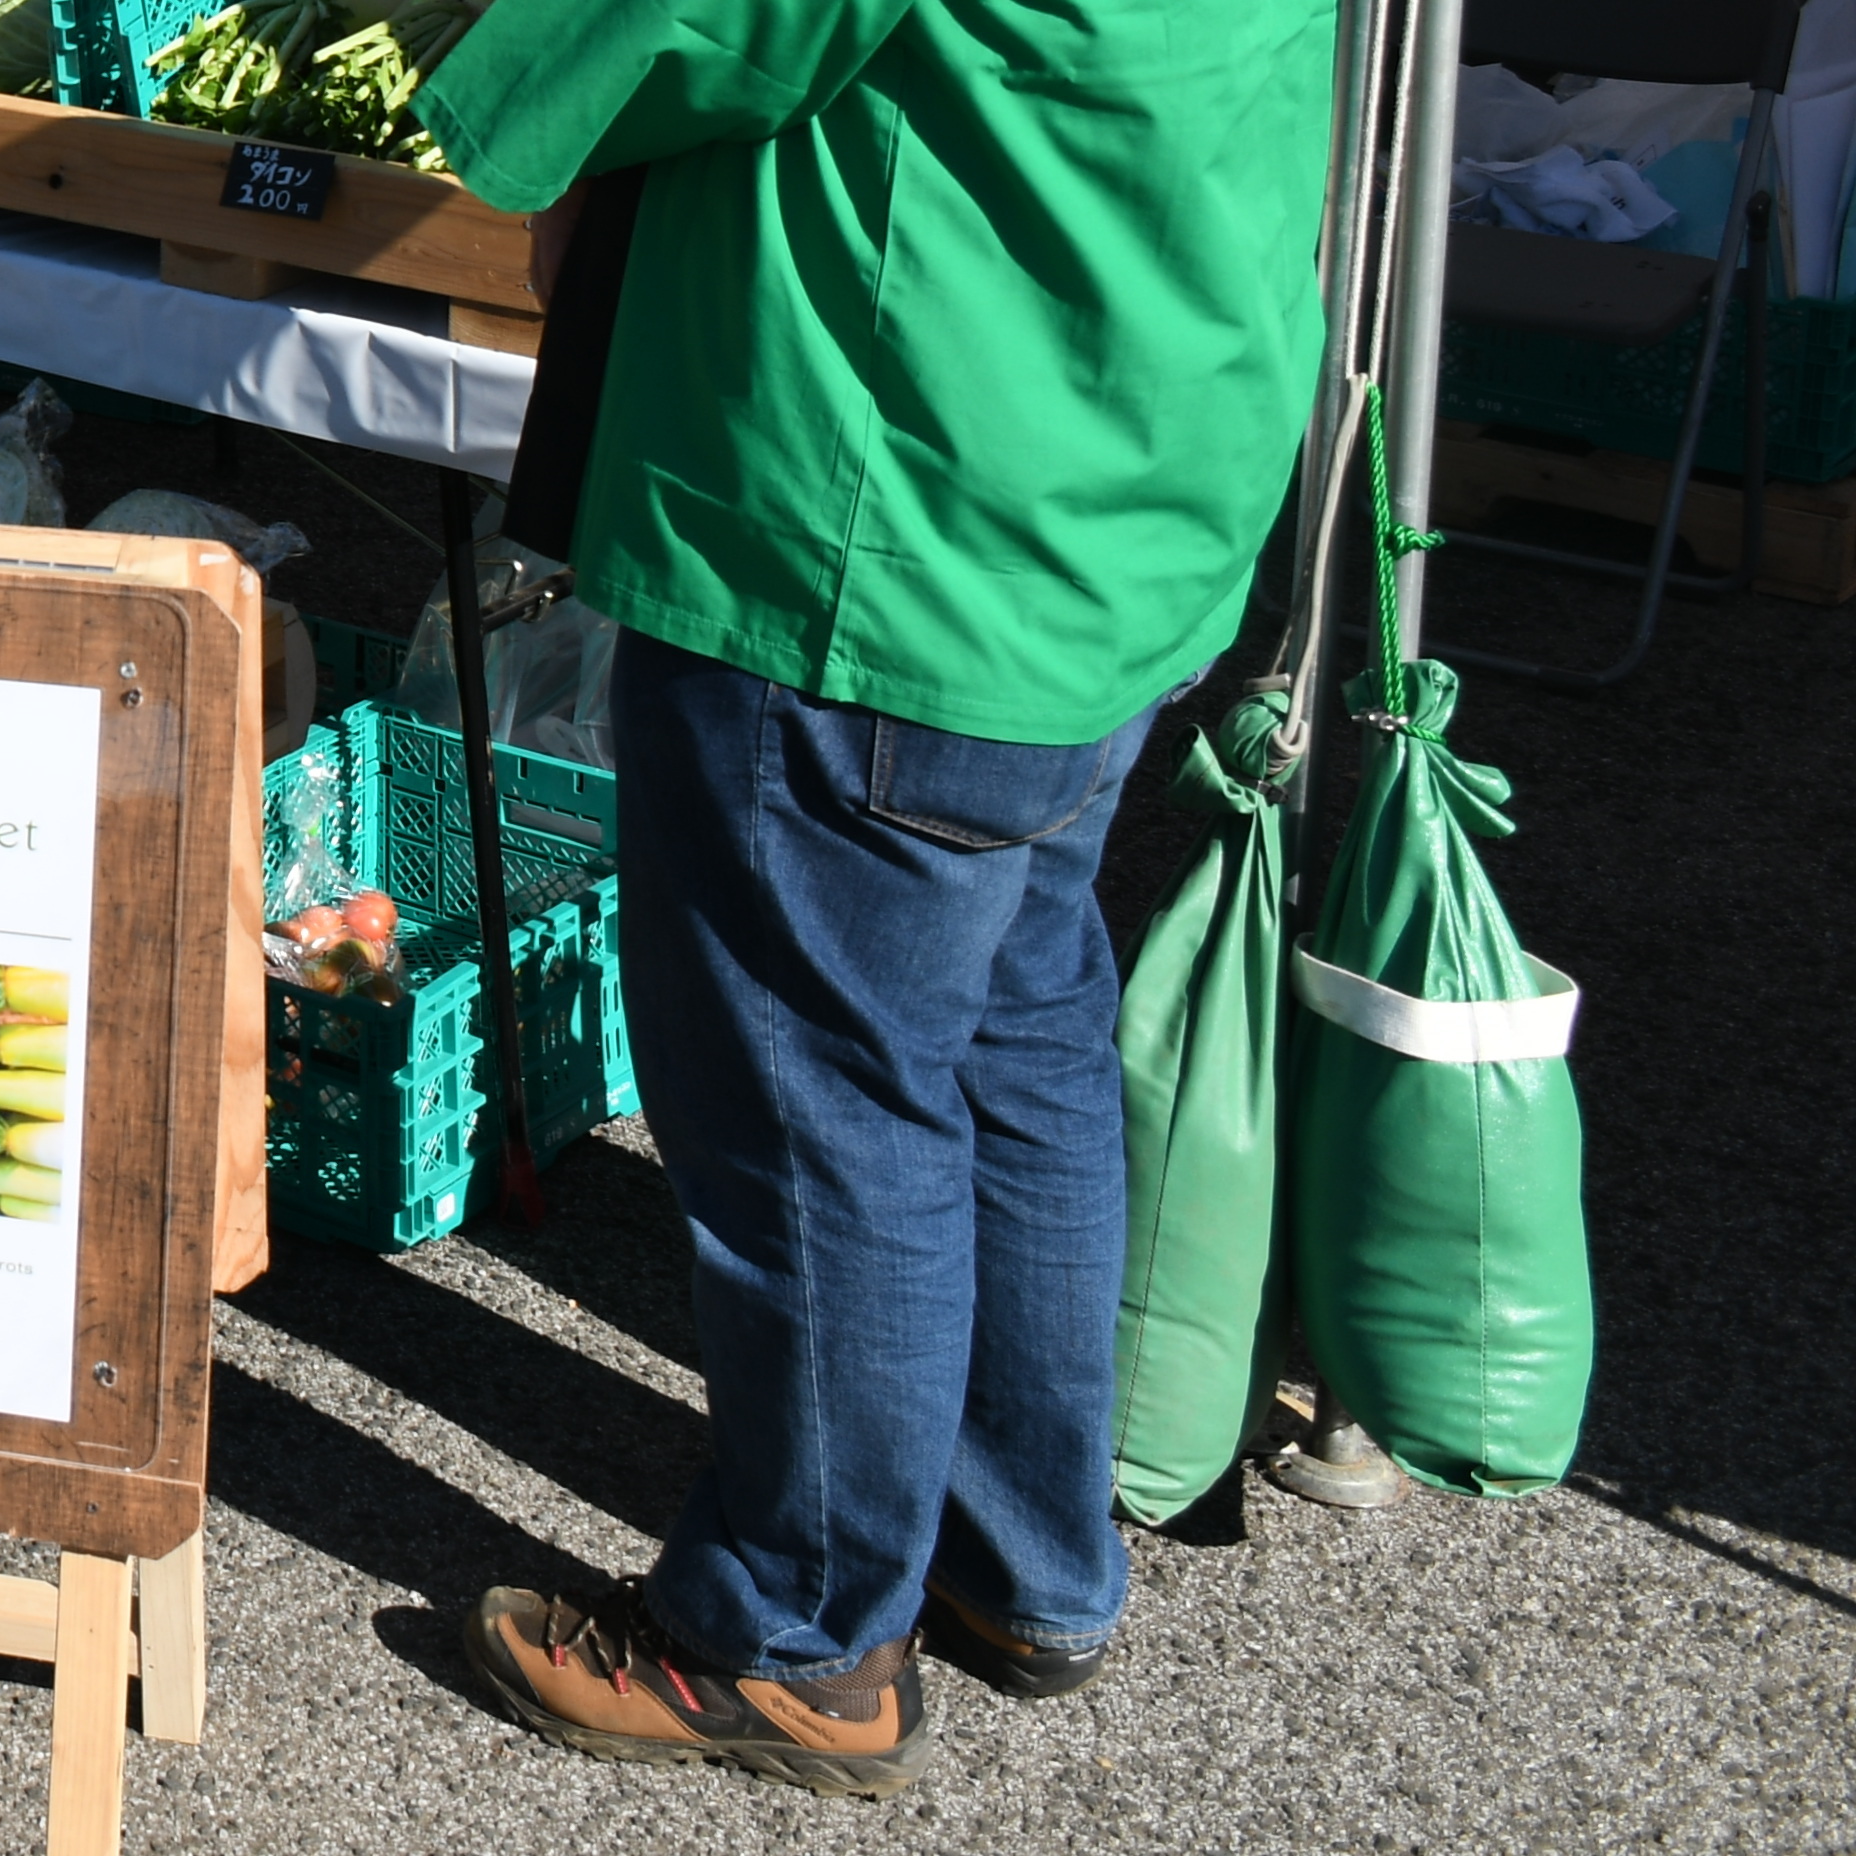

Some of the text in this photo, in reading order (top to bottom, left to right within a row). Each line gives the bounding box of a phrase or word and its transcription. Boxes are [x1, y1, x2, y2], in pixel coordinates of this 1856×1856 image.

[250, 160, 312, 187] ダイコン
[236, 183, 309, 215] 200円
